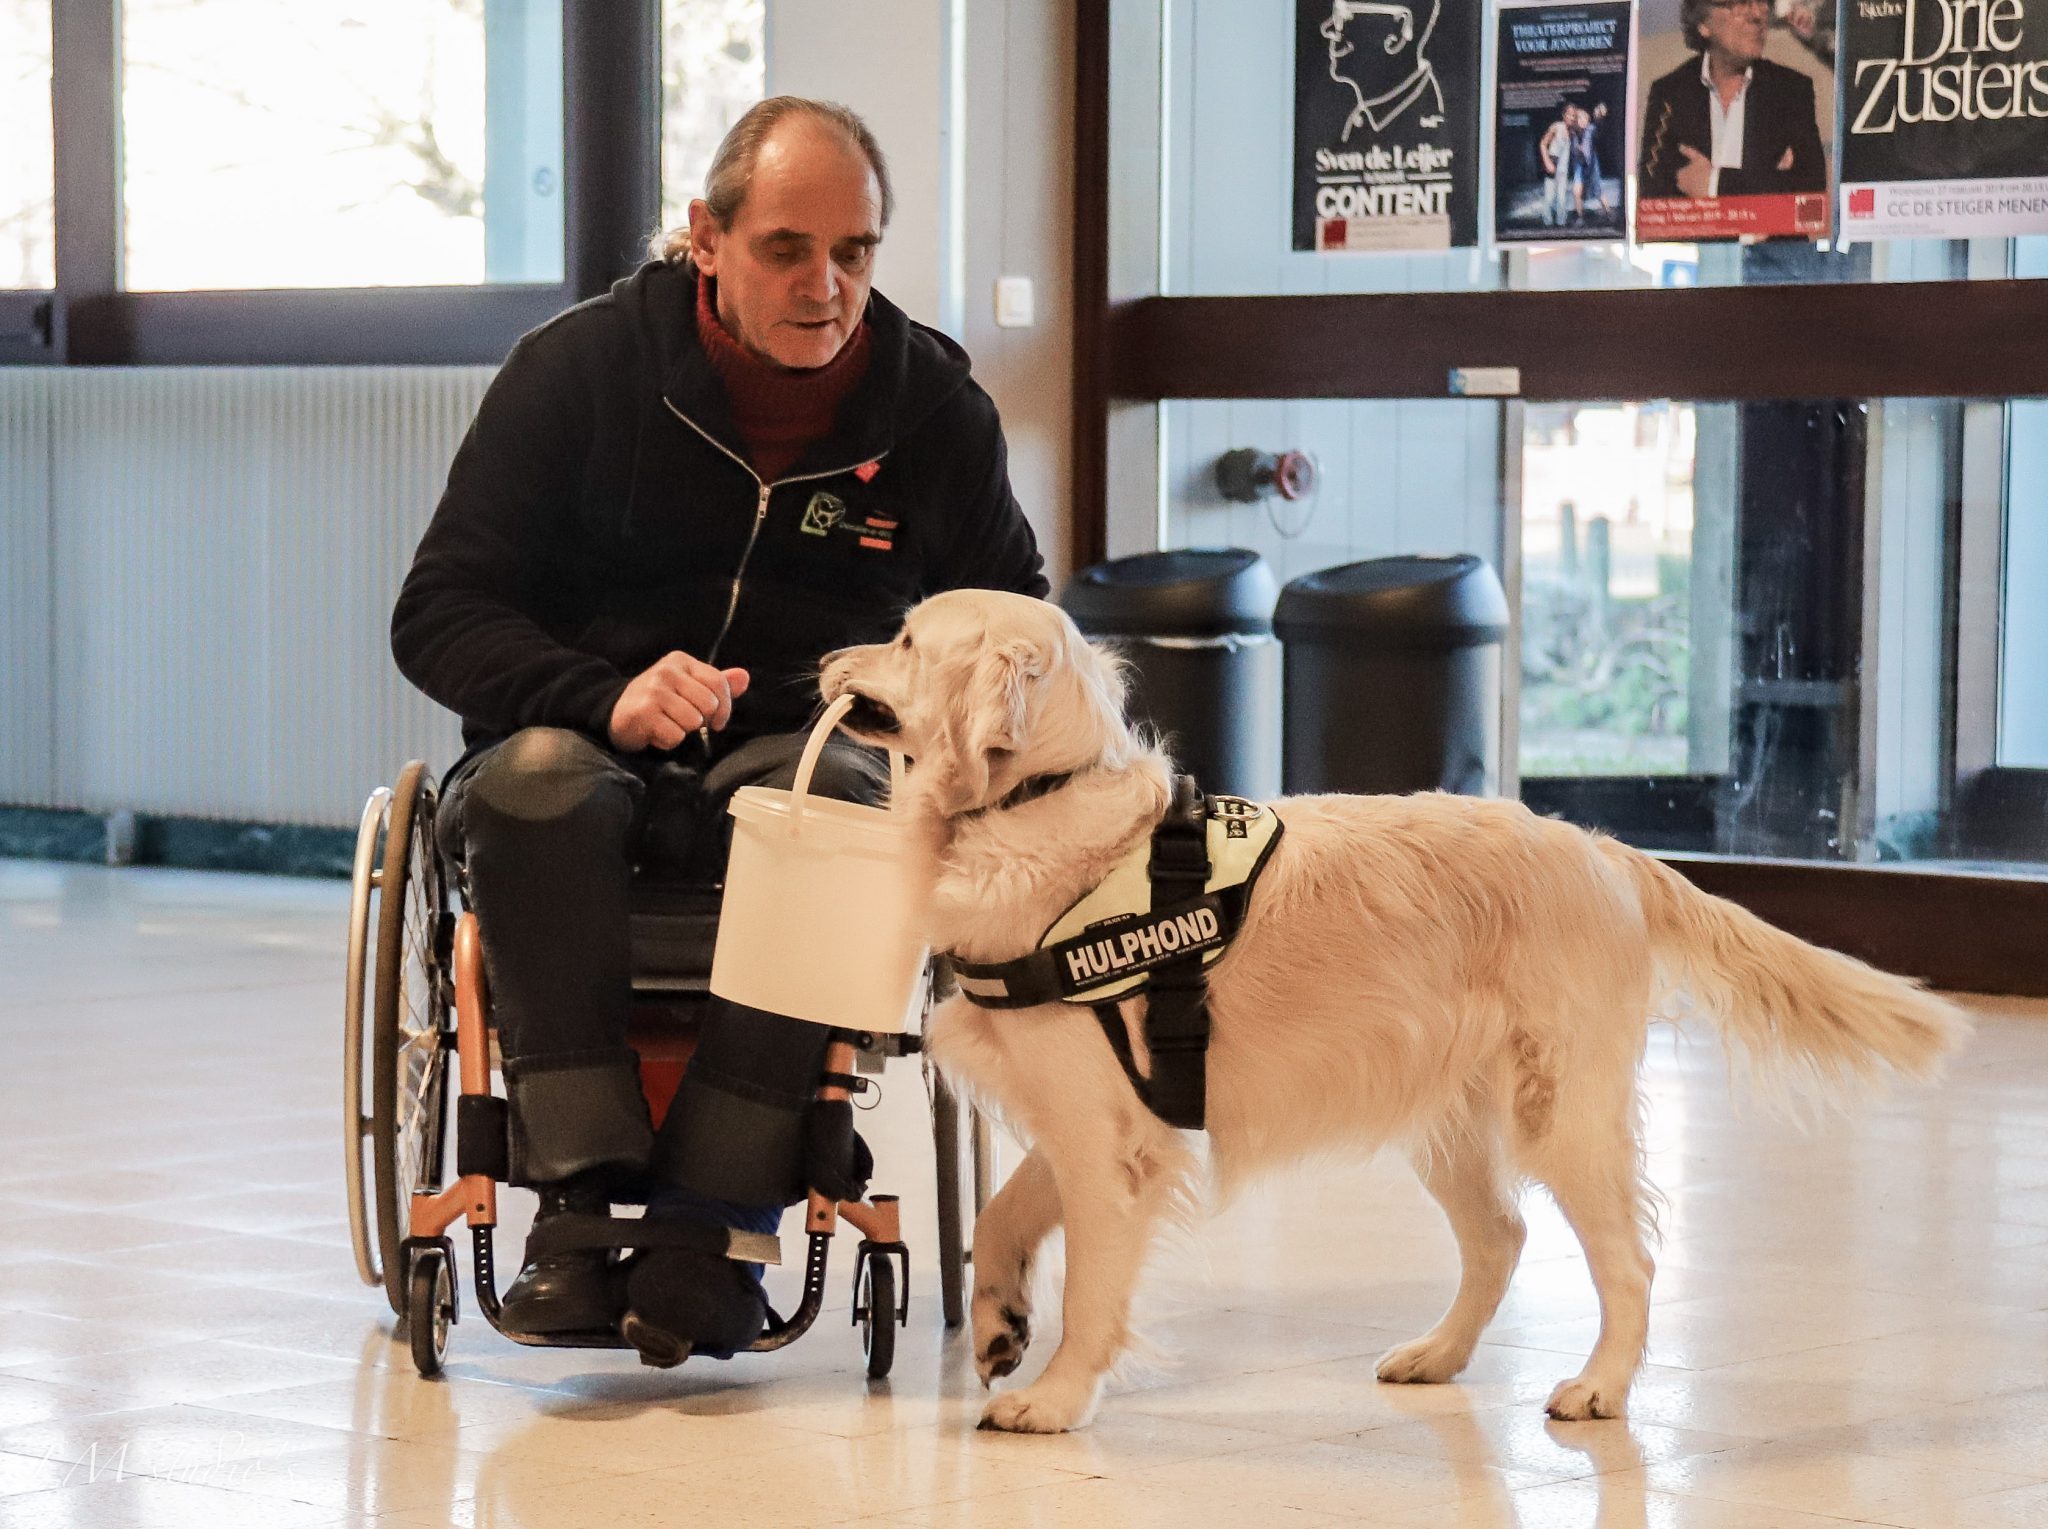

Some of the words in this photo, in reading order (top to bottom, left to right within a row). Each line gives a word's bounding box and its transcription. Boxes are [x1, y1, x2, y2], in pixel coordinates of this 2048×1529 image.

[1902, 0, 2025, 66] Drie
[1851, 52, 2048, 134] Zusters
[1316, 147, 1364, 172] Sven
[1365, 144, 1392, 169] de
[1315, 183, 1453, 218] CONTENT
[1887, 200, 1911, 217] CC
[1913, 200, 1933, 216] DE
[1936, 198, 1994, 216] STEIGER
[1998, 197, 2048, 214] MENEN
[1066, 907, 1218, 981] HULPHOND
